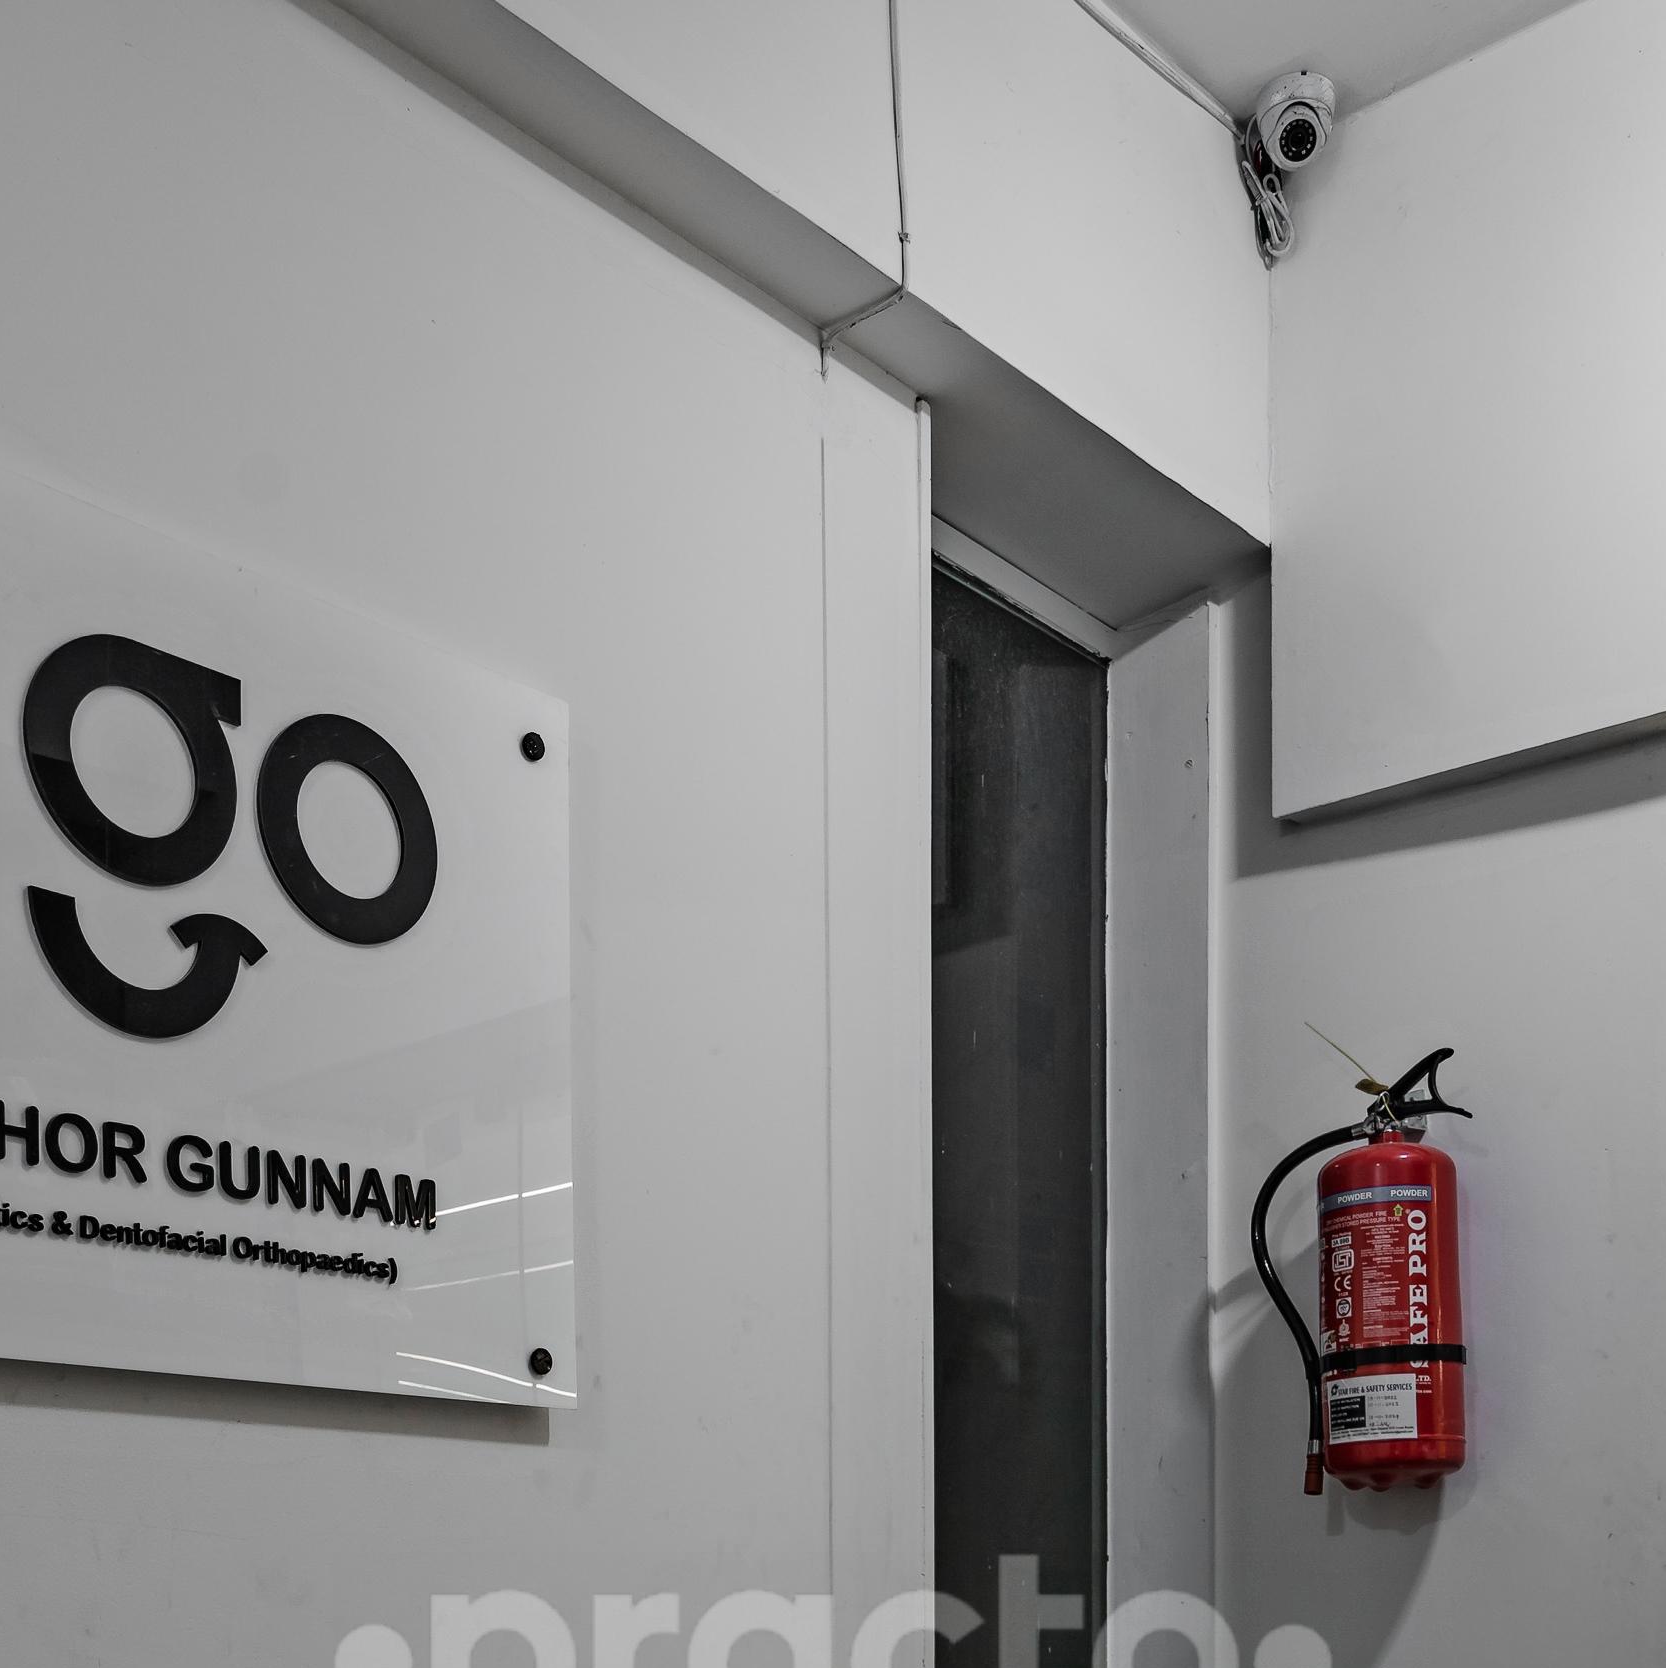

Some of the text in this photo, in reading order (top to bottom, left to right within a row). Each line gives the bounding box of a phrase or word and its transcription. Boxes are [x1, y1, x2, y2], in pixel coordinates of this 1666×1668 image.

[166, 1134, 437, 1231] GUNNAM
[1338, 1189, 1428, 1204] POWDER POWDER
[50, 1210, 74, 1238] &
[78, 1214, 226, 1257] Dentofacial
[231, 1236, 398, 1285] Orthopaedics)
[1408, 1209, 1427, 1277] PRO
[1366, 1384, 1385, 1393] SAFETY
[1386, 1383, 1413, 1392] SERVICES
